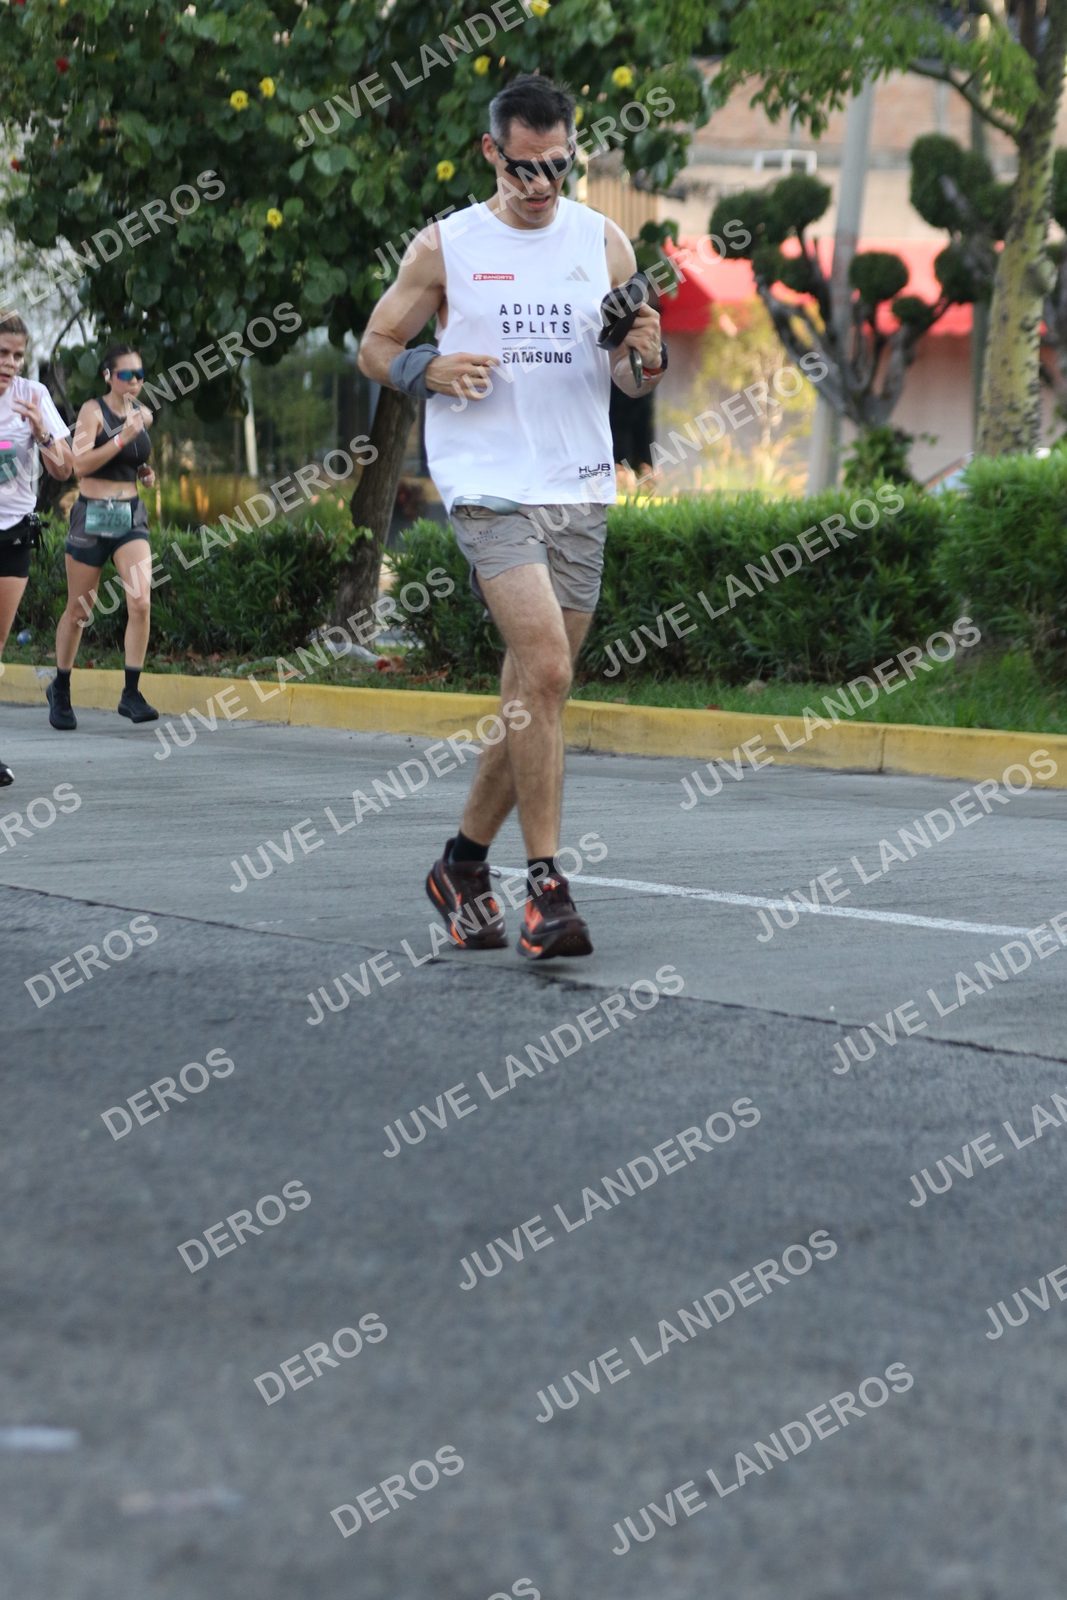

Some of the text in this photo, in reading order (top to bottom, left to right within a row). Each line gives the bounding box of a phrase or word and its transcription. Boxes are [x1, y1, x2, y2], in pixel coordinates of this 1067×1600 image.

[499, 303, 572, 316] ADIDAS
[502, 321, 570, 334] SPLITS
[502, 351, 572, 364] SAMSUNG
[579, 463, 611, 474] HUB
